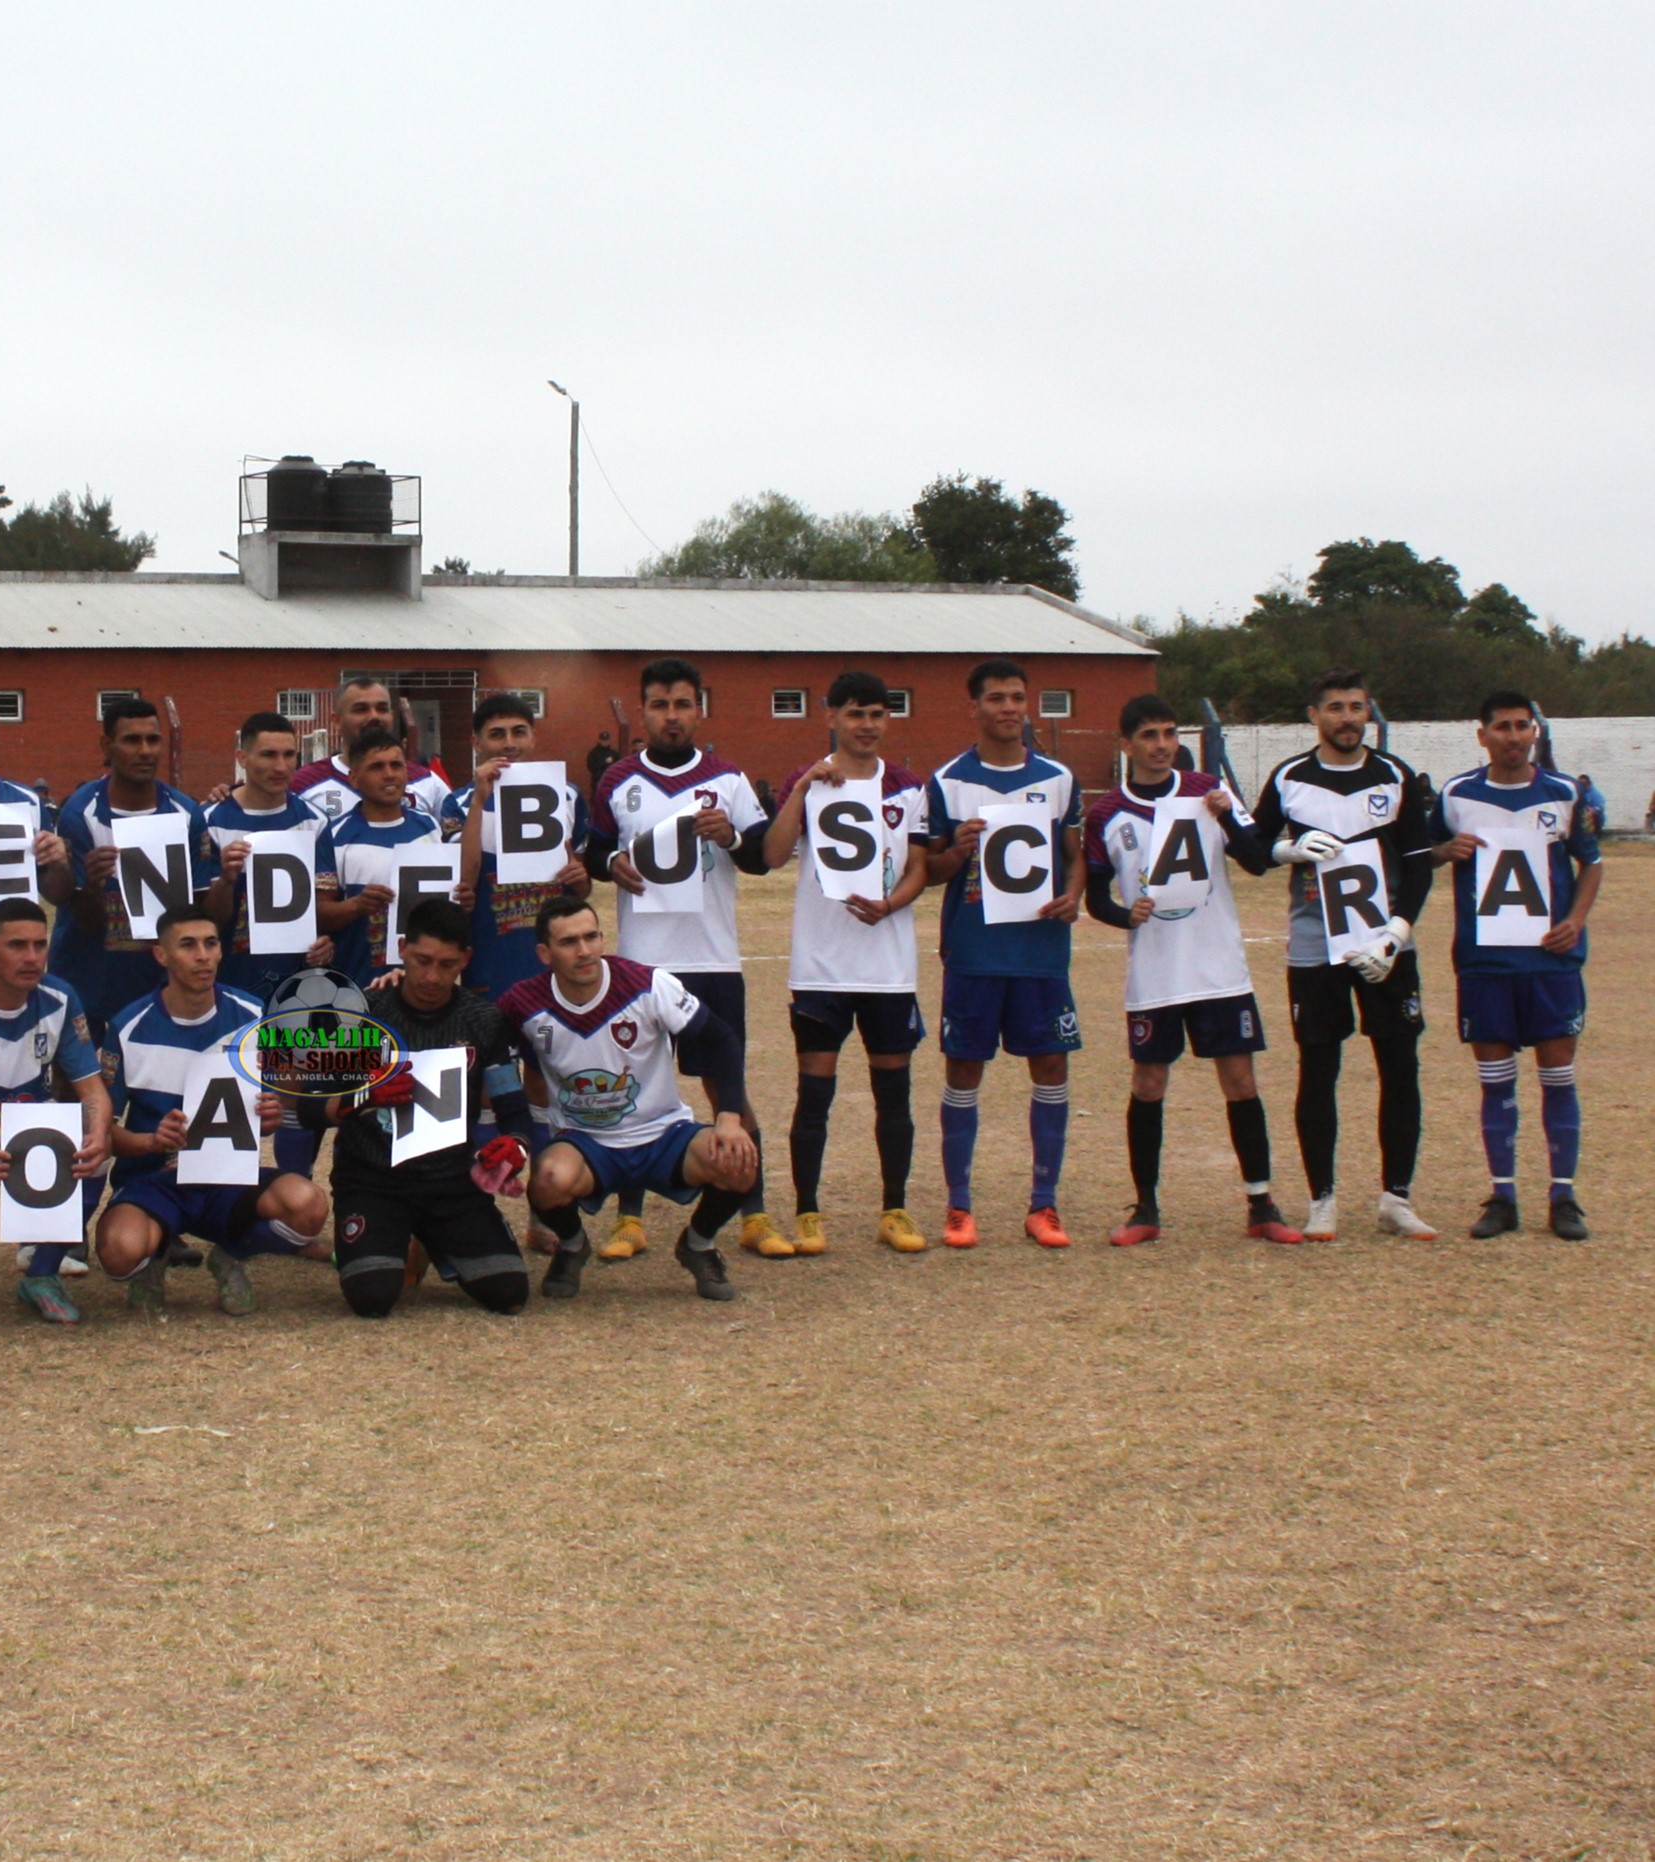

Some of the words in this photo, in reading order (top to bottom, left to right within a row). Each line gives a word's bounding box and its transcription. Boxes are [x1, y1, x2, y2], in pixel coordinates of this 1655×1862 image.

[325, 790, 342, 816] 5
[499, 784, 564, 853] B
[626, 785, 642, 812] 6
[632, 815, 699, 884] U
[817, 801, 876, 872] S
[984, 824, 1049, 894] C
[1148, 819, 1210, 886] A
[120, 844, 191, 918] N
[252, 853, 311, 923] D
[1321, 864, 1387, 938] R
[1477, 850, 1549, 917] A
[185, 1076, 258, 1151] A
[395, 1065, 462, 1140] N
[2, 1127, 81, 1209] O
